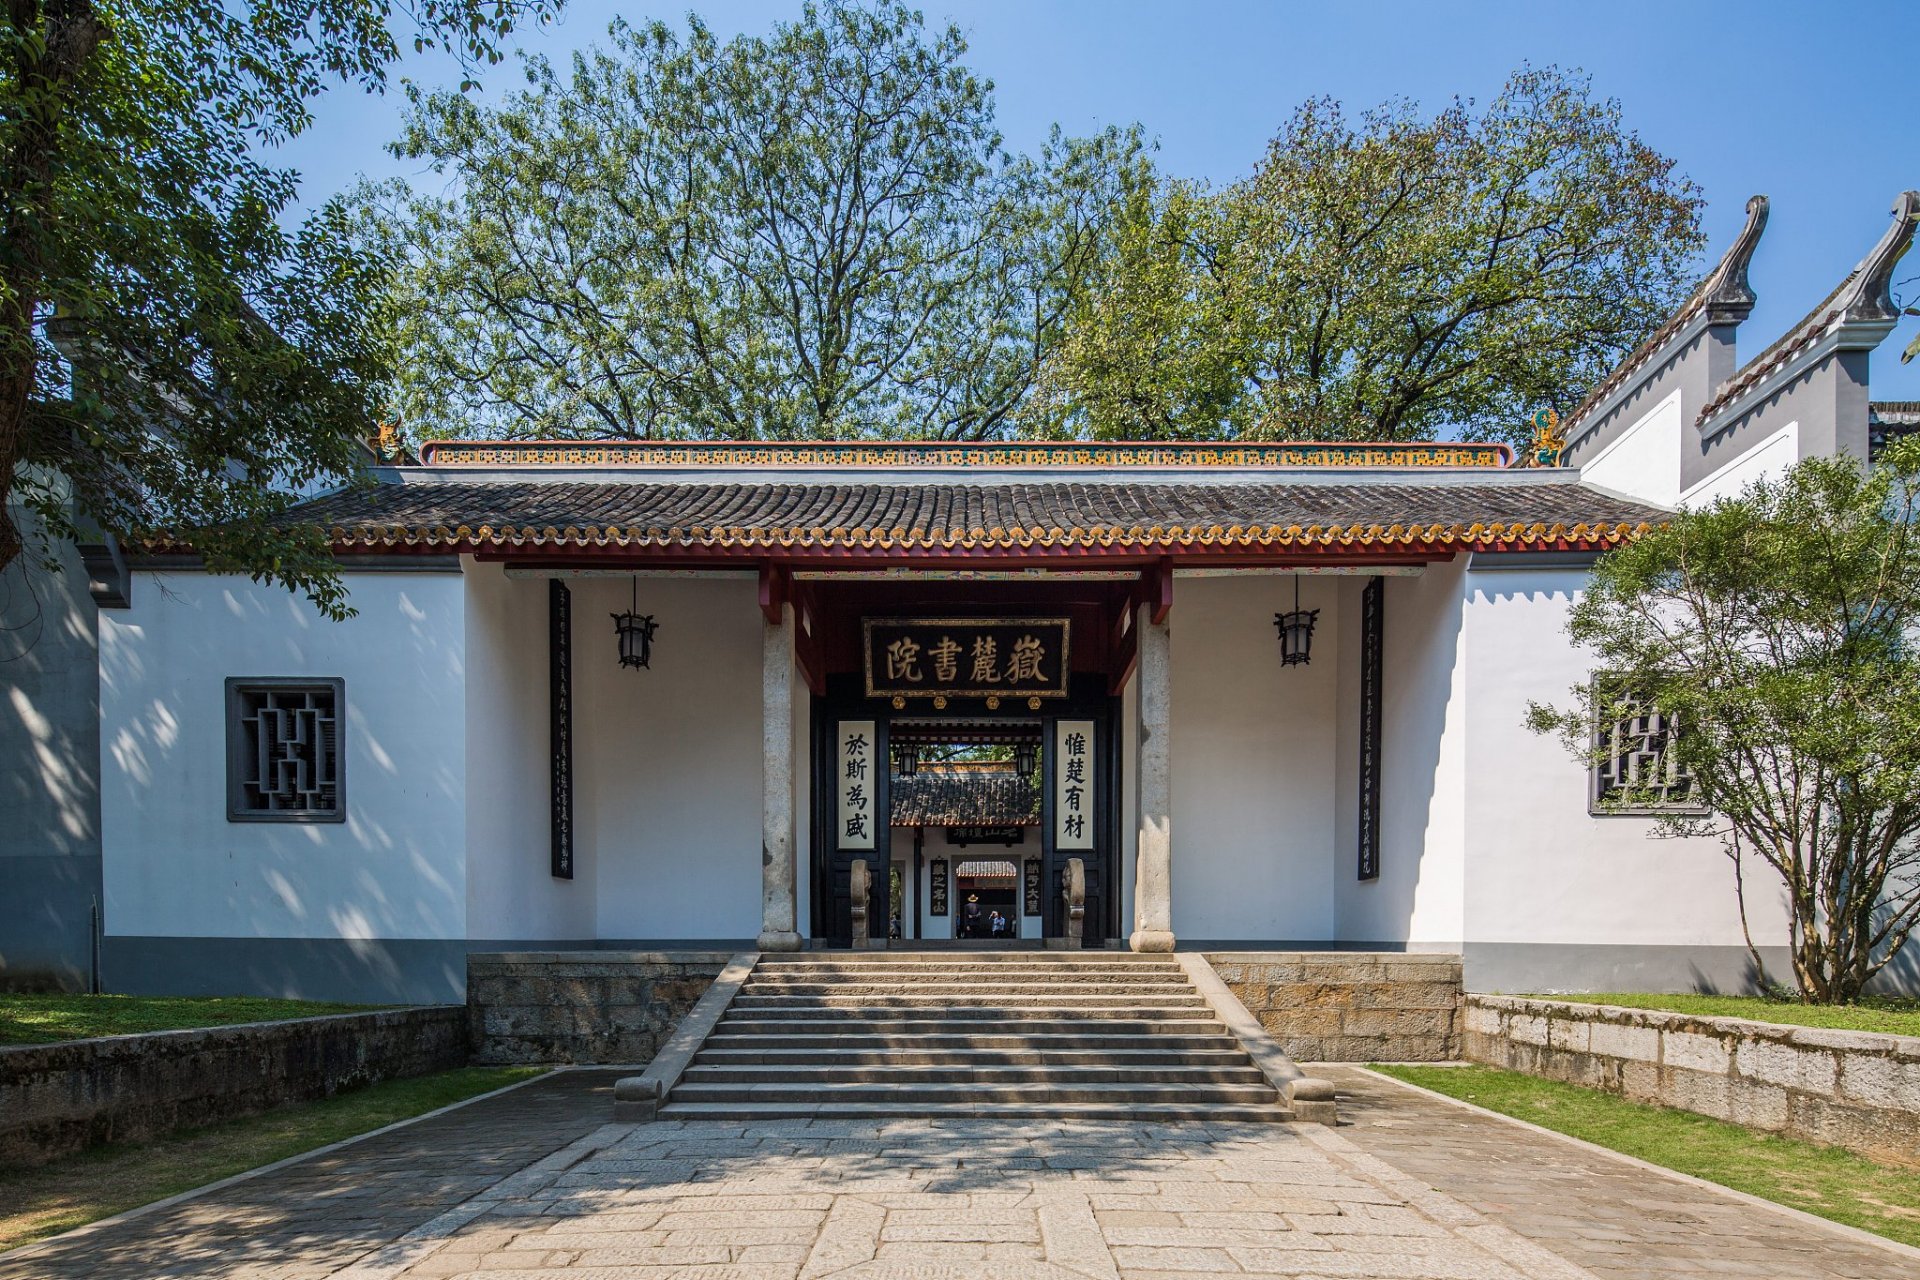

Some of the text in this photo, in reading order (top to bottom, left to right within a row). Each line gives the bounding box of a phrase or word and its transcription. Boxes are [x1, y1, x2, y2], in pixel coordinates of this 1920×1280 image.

[886, 634, 1049, 684] 嶽麓書院
[1064, 732, 1086, 841] 惟楚有材
